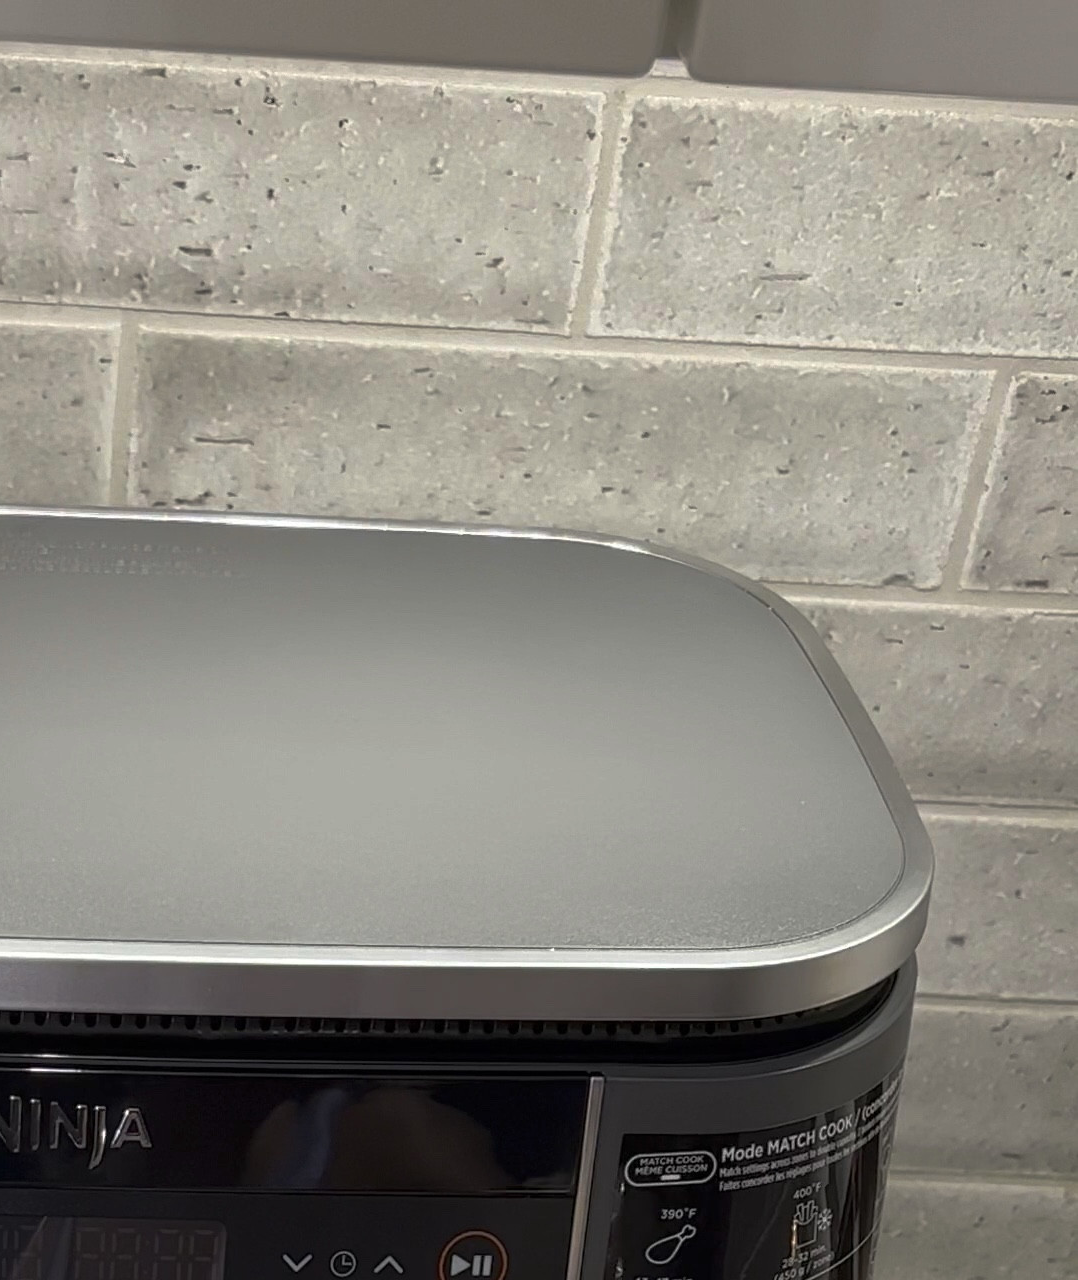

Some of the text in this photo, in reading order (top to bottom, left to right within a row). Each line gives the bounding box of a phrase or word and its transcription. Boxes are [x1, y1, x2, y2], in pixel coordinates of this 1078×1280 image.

[722, 1143, 764, 1163] Mode
[767, 1130, 816, 1156] MATCH
[818, 1113, 854, 1141] COOK
[639, 1155, 705, 1166] MATCH COOK
[665, 1163, 708, 1174] CUISSON
